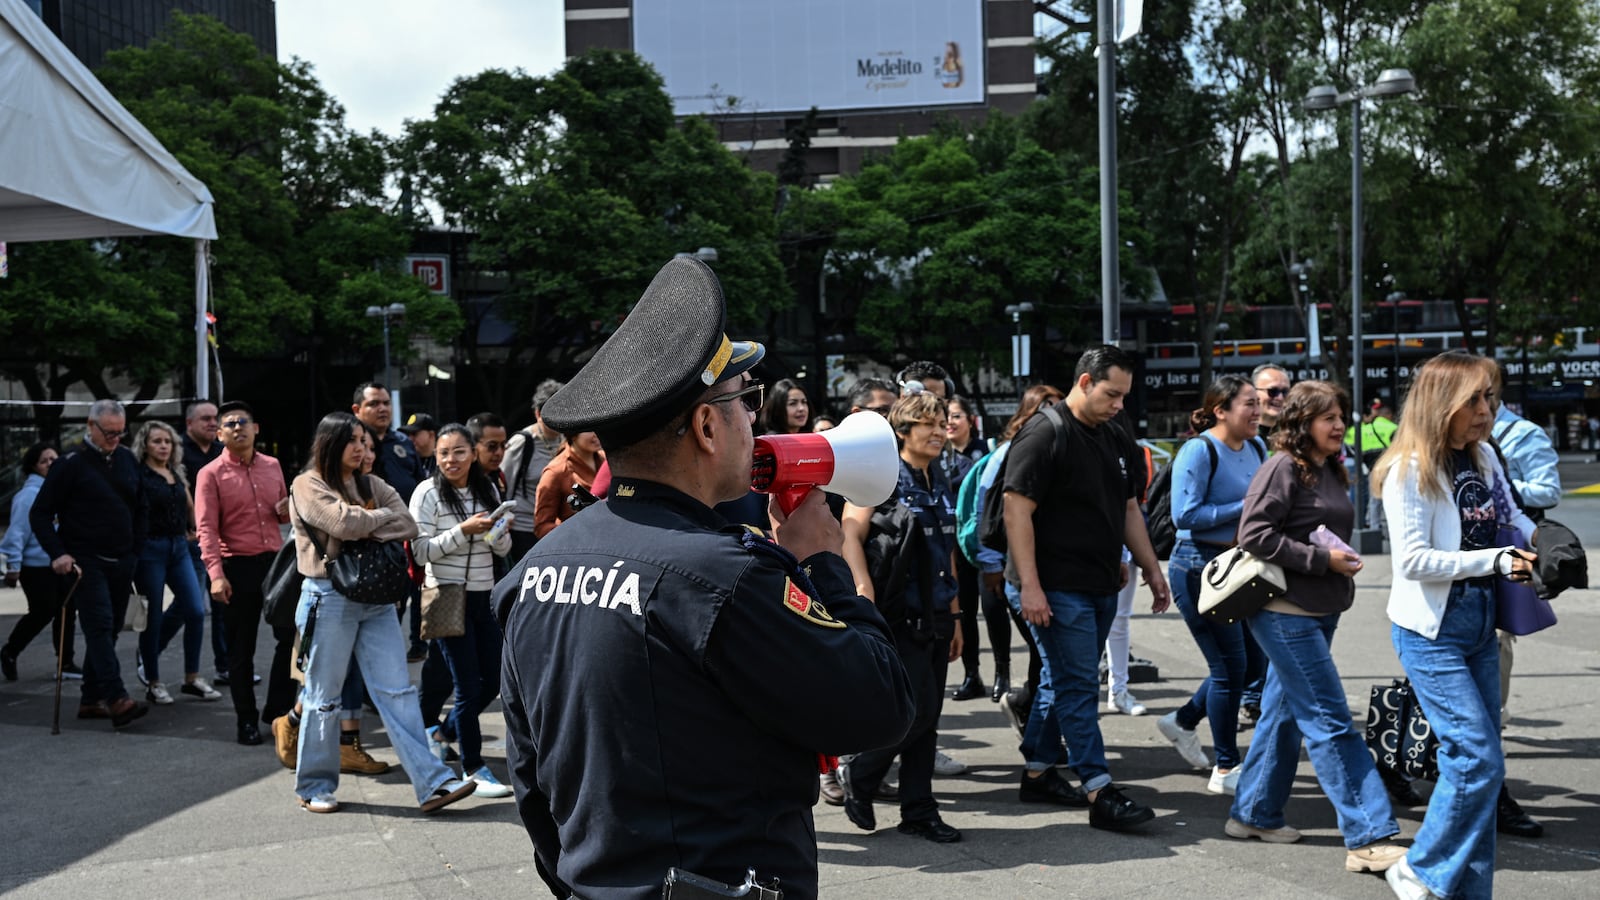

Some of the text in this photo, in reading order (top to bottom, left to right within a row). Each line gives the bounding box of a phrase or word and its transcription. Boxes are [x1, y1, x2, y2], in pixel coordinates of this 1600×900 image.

[857, 58, 922, 77] Modelito
[1167, 371, 1188, 384] las
[1561, 361, 1600, 373] voce
[520, 560, 642, 615] POLICÍA
